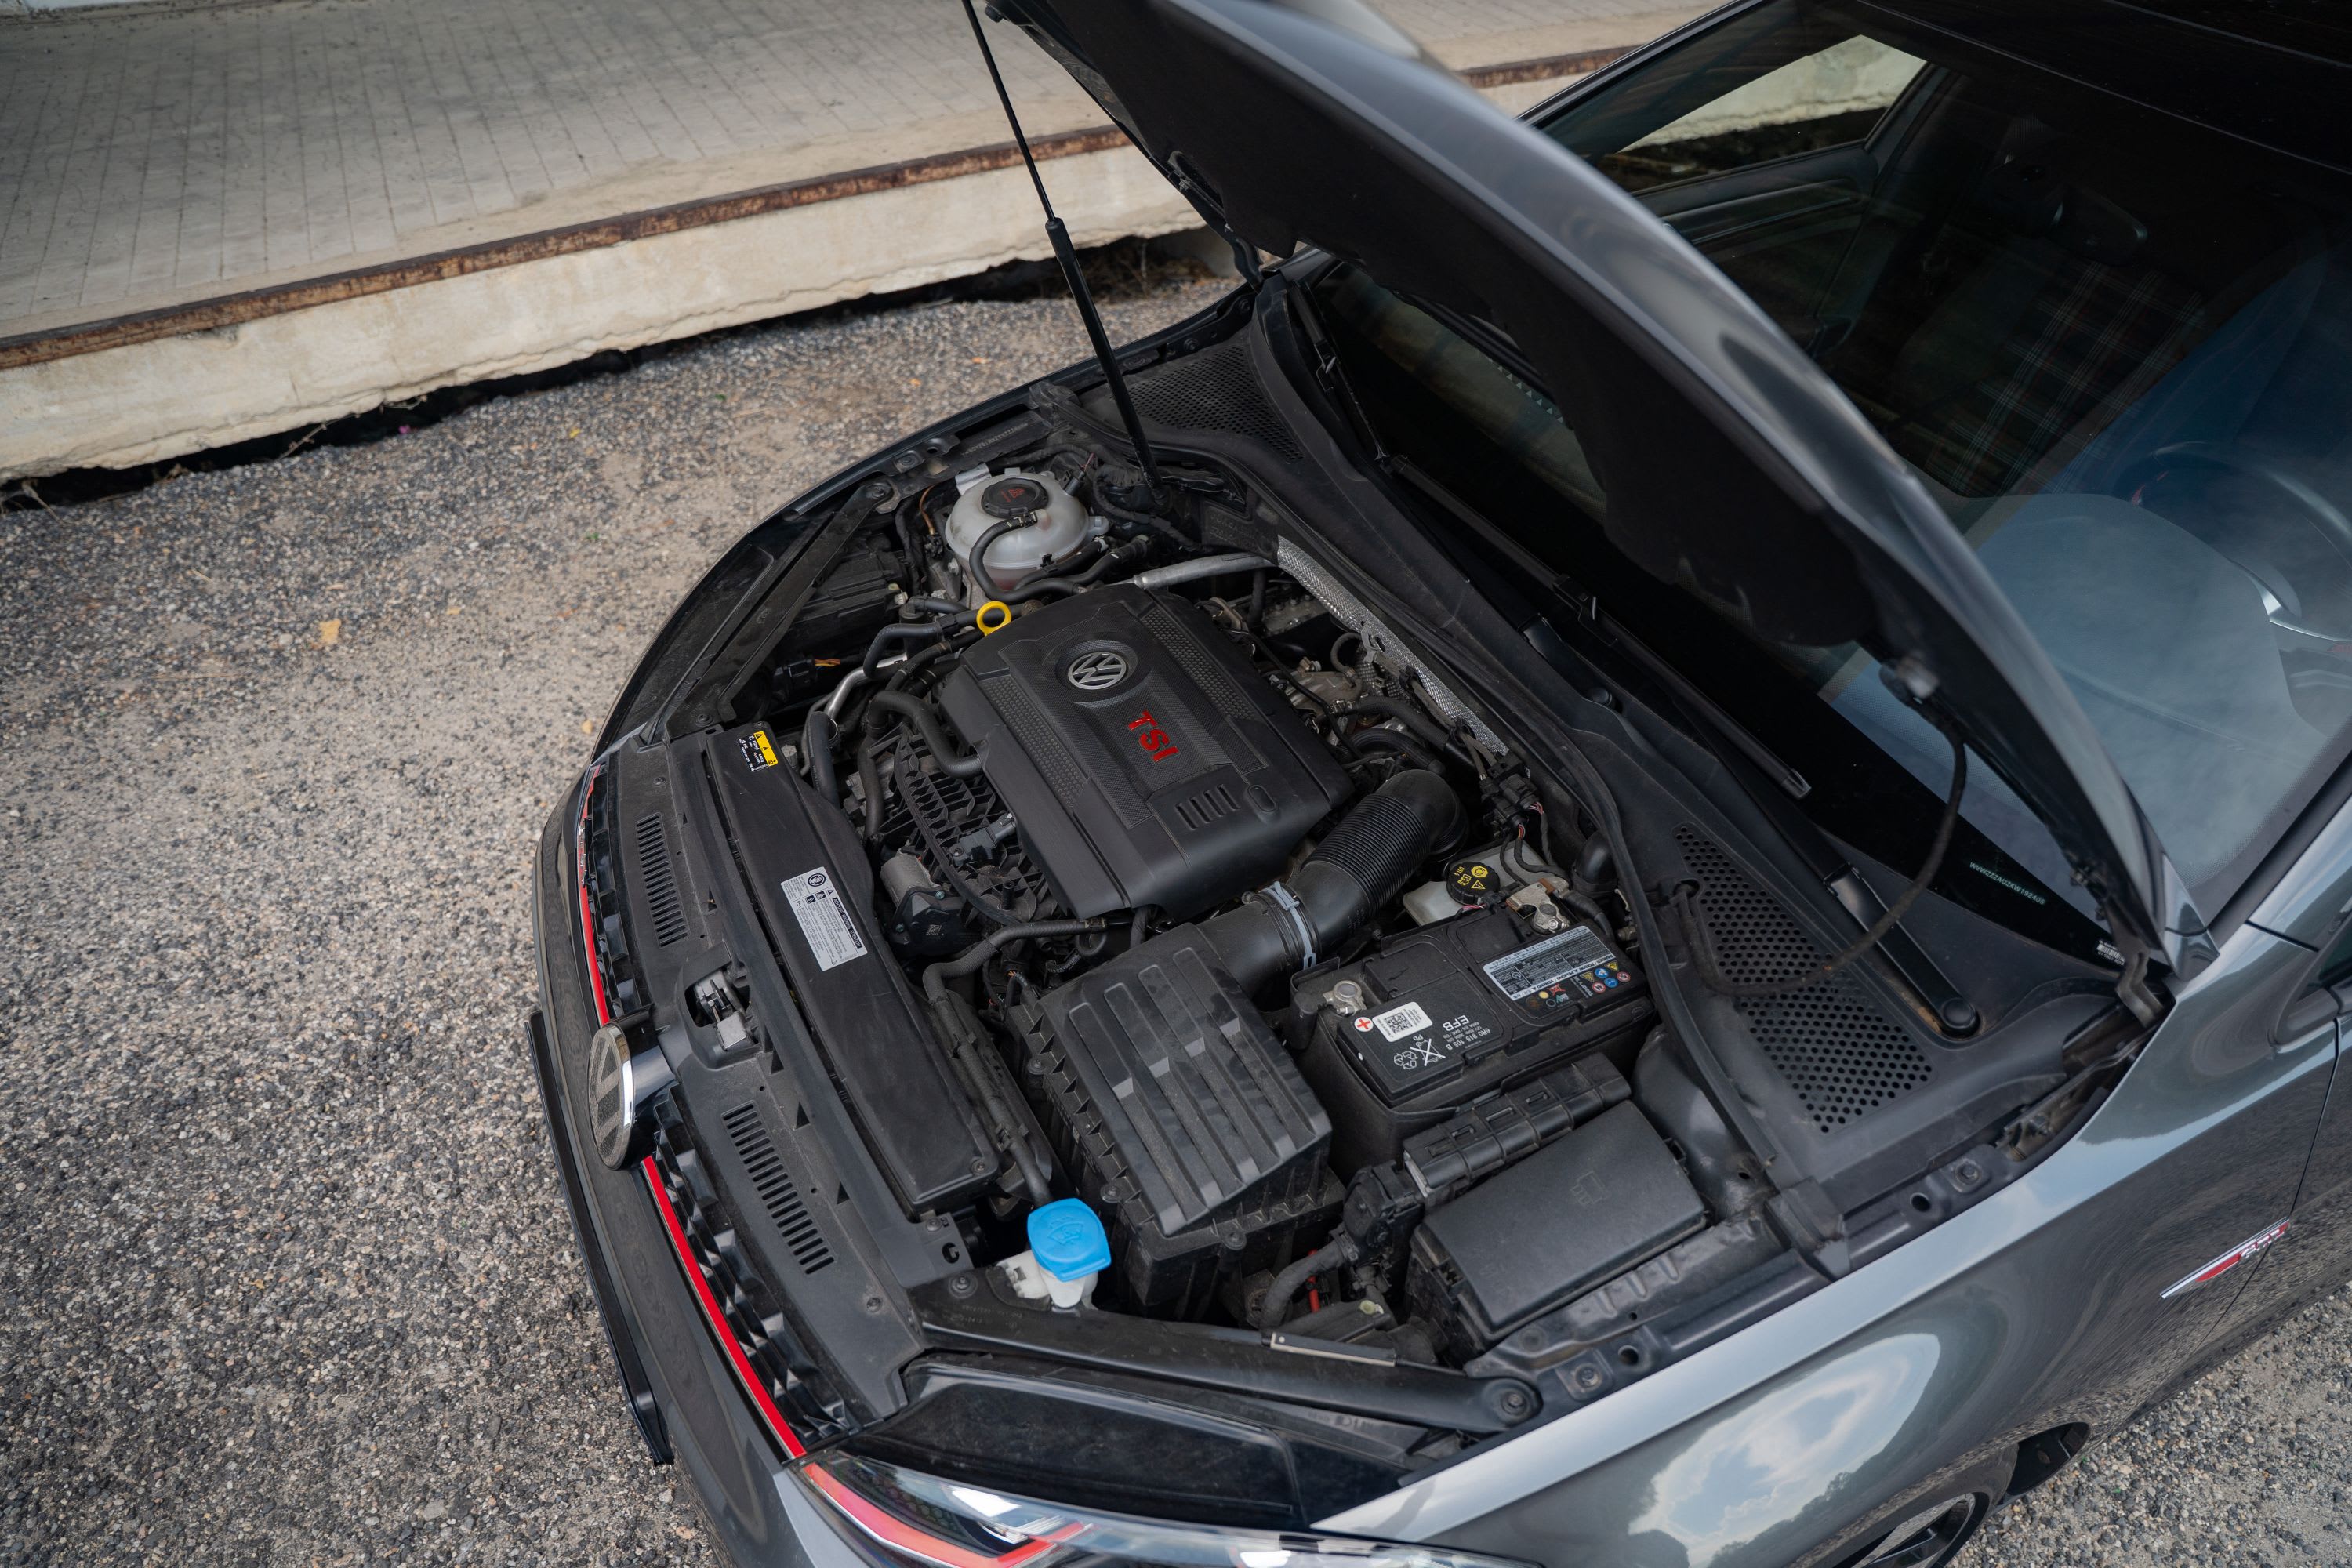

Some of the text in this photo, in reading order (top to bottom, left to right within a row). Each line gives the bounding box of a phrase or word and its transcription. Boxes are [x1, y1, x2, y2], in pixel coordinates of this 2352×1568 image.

[1127, 709, 1180, 764] TSI
[848, 928, 861, 947] ATTENTION
[1443, 1014, 1470, 1031] EFB
[1465, 1033, 1478, 1042] 915
[1478, 1028, 1490, 1036] 6R0
